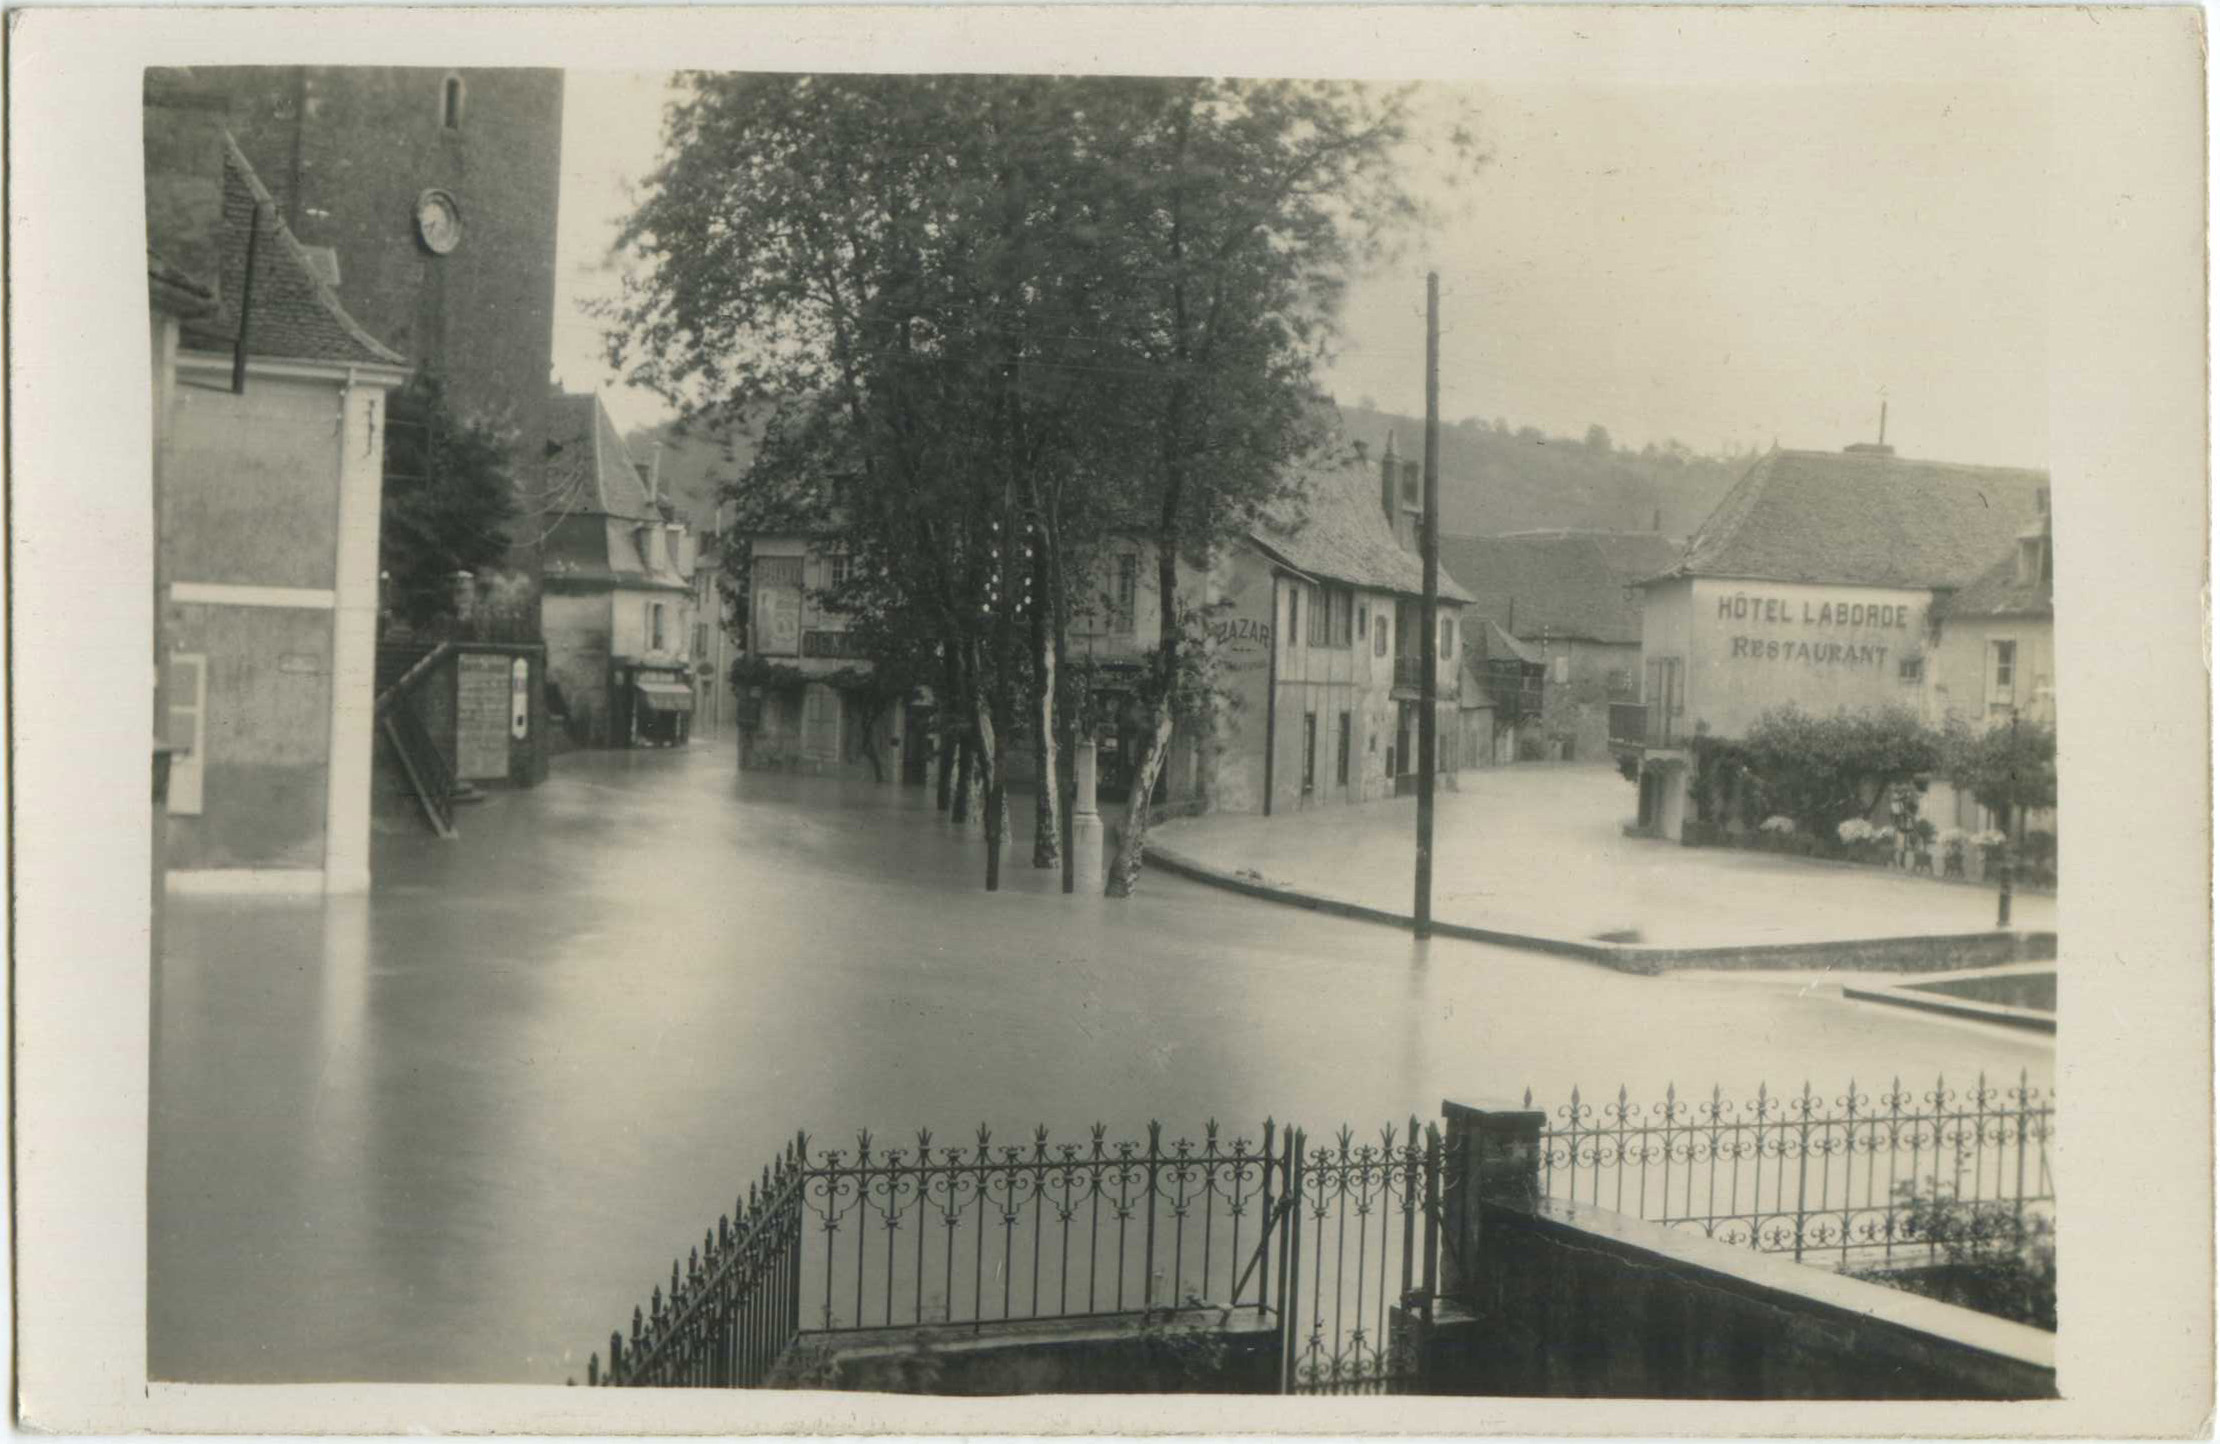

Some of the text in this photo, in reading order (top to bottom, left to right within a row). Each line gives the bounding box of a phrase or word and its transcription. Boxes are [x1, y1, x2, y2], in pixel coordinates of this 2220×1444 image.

[1718, 591, 1909, 629] HÔTEL LABORDE
[1731, 635, 1889, 670] RESTAURANT
